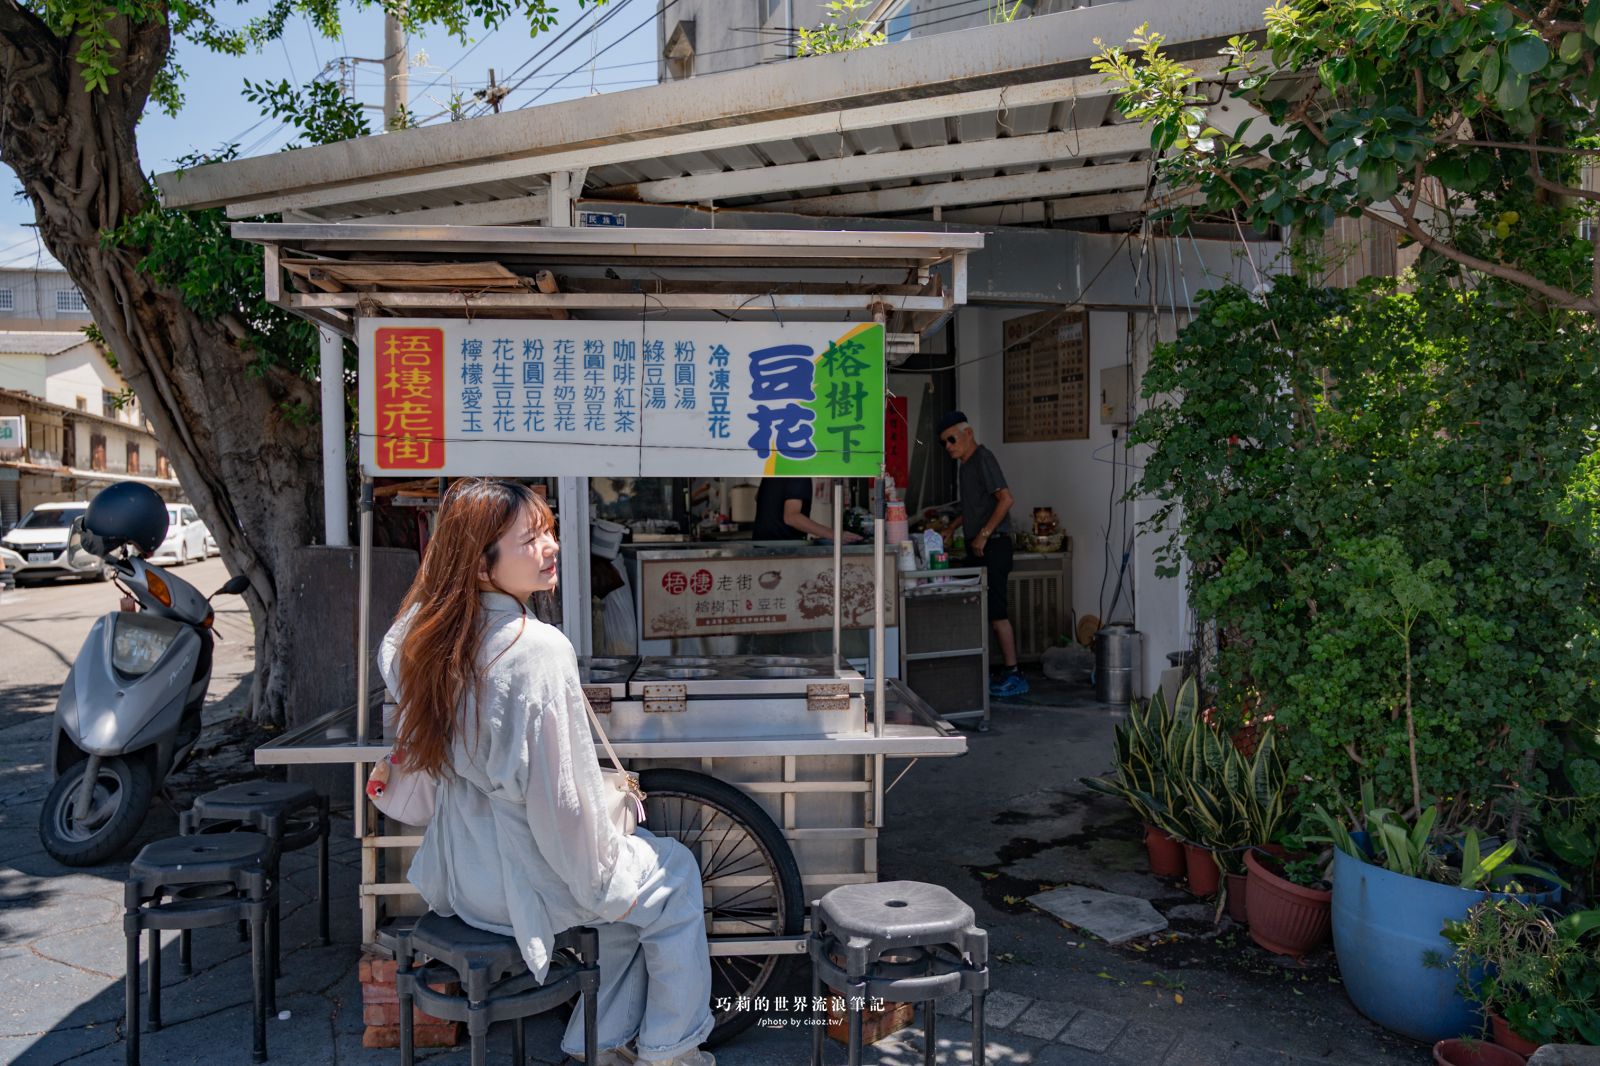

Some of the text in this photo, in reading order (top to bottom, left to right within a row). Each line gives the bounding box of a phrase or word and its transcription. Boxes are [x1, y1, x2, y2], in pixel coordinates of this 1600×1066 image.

[382, 335, 433, 464] 梧棲老街
[461, 338, 484, 433] 檸檬愛玉
[492, 339, 515, 433] 花生豆花
[522, 339, 545, 433] 粉圓豆花
[553, 339, 576, 432] 花生牛奶豆花
[583, 339, 606, 432] 粉圓牛奶豆花
[613, 339, 636, 433] 咖啡紅茶
[643, 339, 666, 410] 綠豆湯
[674, 340, 696, 410] 粉圓湯
[708, 344, 731, 439] 冷凍豆花
[747, 344, 817, 459] 豆花
[822, 339, 871, 464] 榕樹下
[664, 569, 752, 595] 梧棲老街
[758, 597, 787, 610] 豆花
